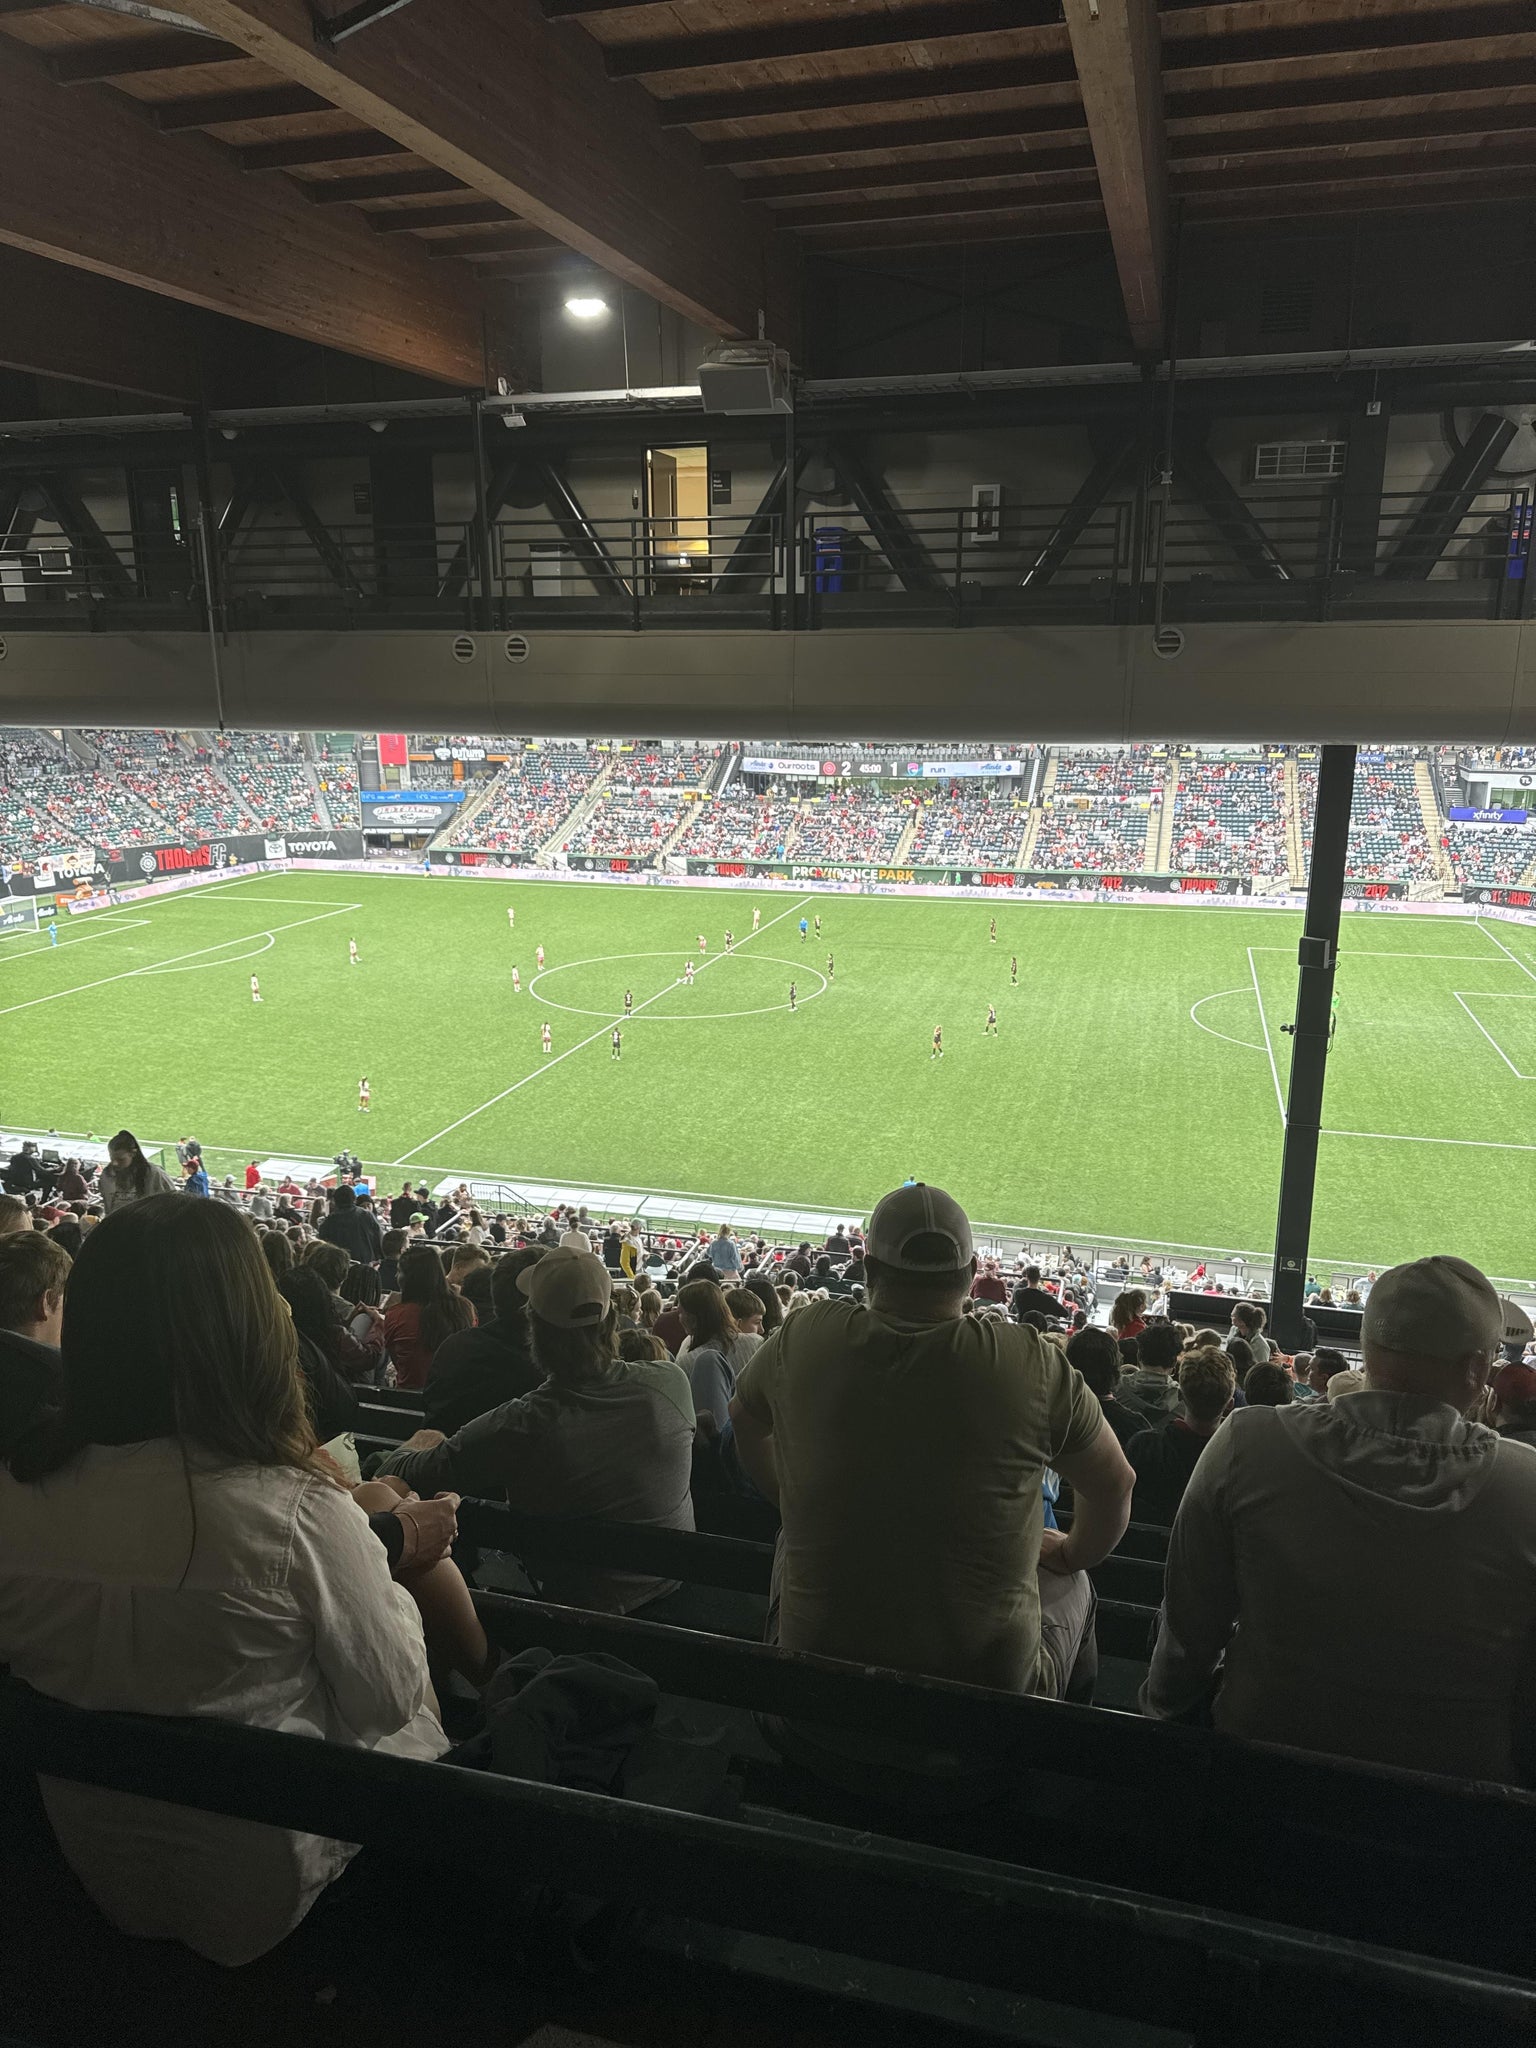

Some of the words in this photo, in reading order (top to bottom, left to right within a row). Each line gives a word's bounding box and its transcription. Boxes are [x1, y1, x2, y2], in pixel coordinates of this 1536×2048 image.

[841, 761, 851, 776] 2
[859, 764, 882, 773] 45:00
[890, 761, 898, 776] 1
[287, 840, 337, 853] TOYOTA
[611, 859, 629, 871] 2012
[879, 869, 915, 881] PARK
[1101, 877, 1123, 888] 2012
[1181, 878, 1218, 891] THORNS
[1364, 884, 1389, 898] 2012
